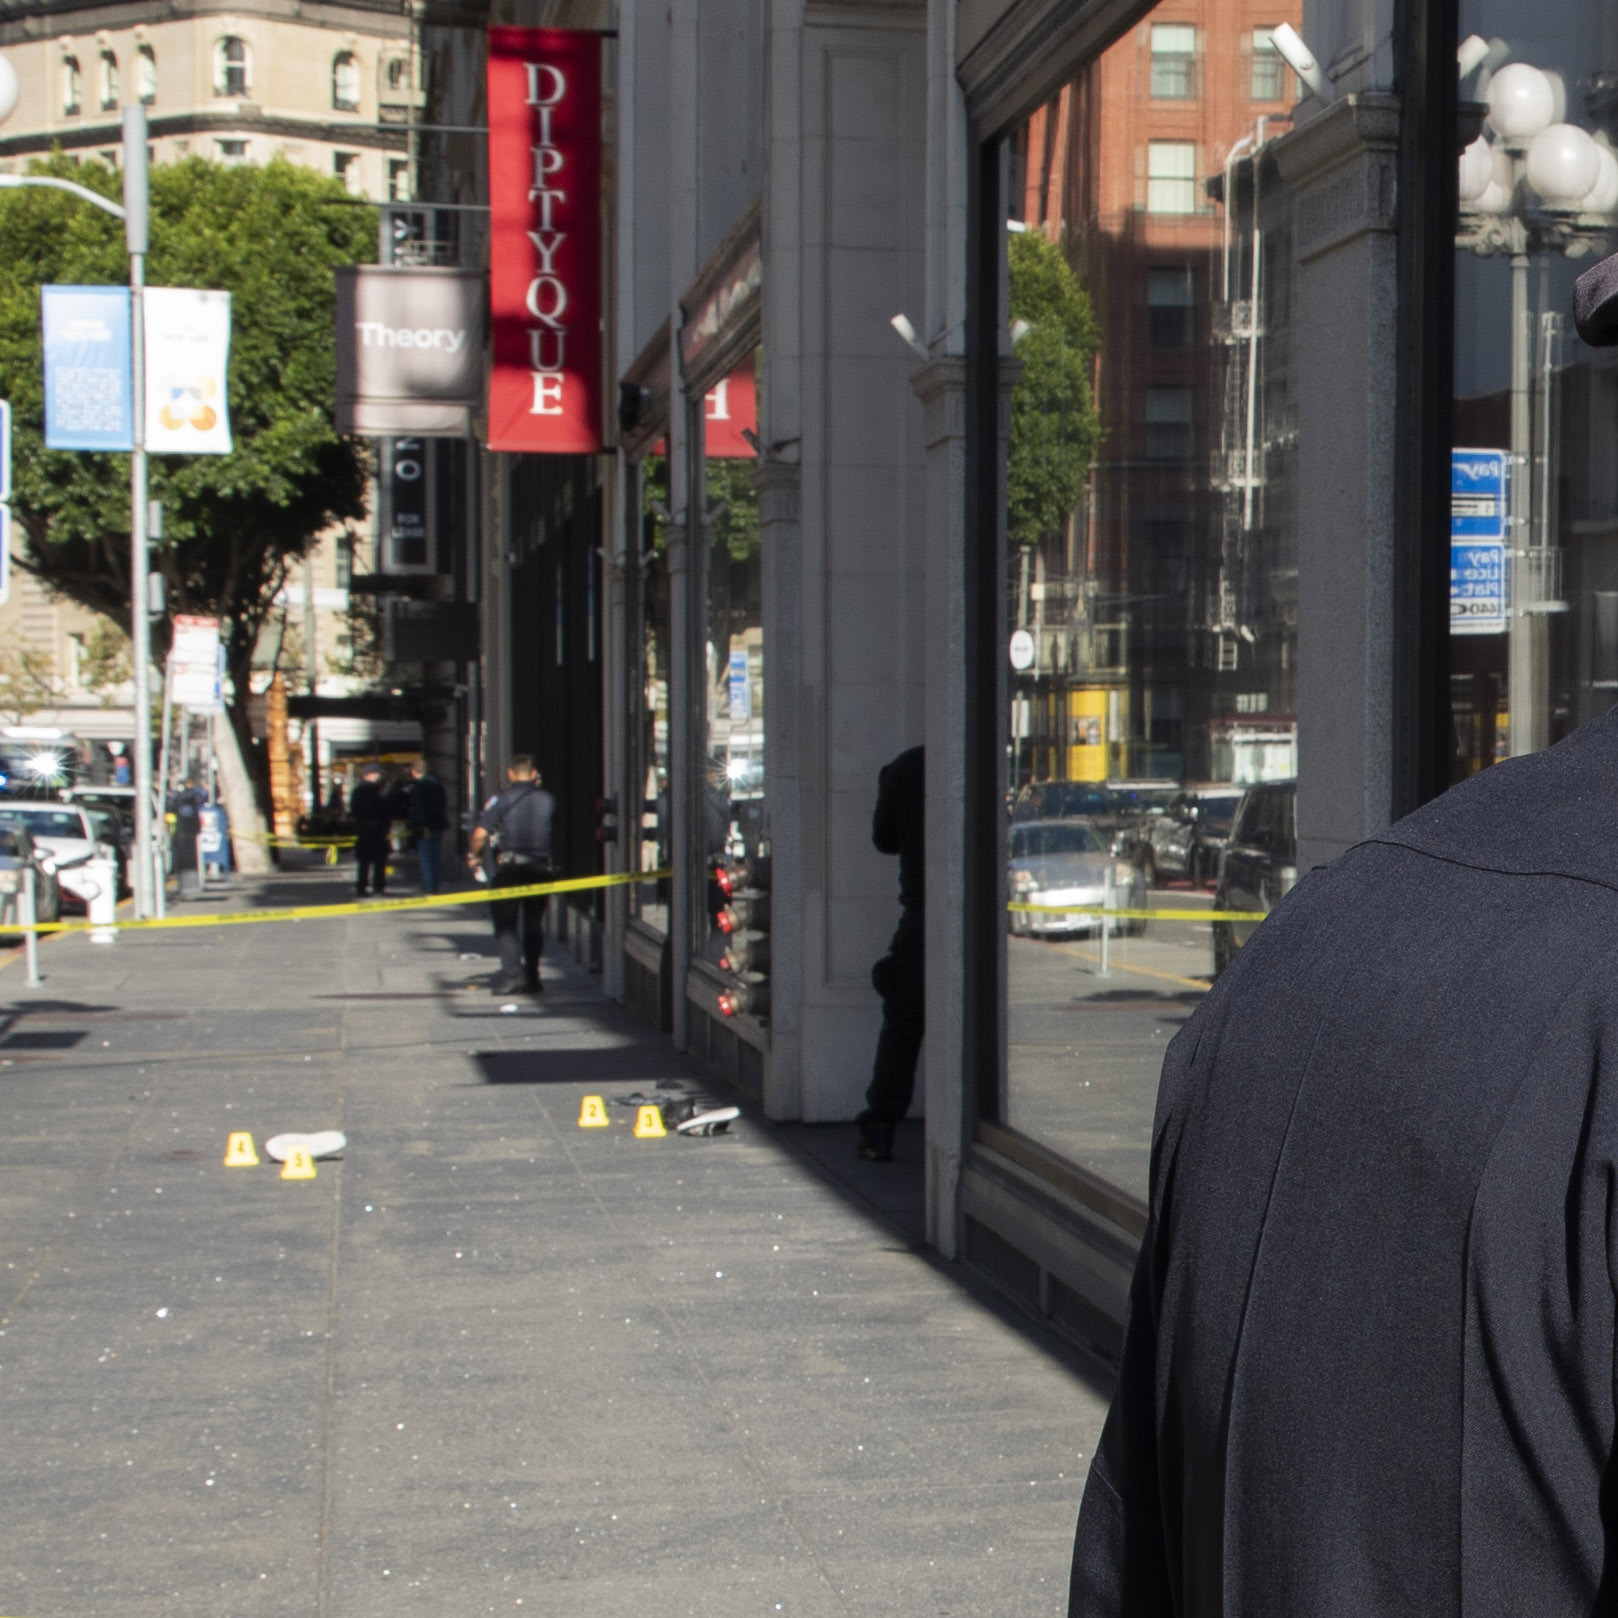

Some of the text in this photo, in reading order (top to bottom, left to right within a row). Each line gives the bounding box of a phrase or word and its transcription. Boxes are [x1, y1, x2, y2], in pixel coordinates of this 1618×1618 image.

[523, 62, 568, 415] DIPTYQUE
[356, 321, 466, 354] Theory
[588, 1103, 598, 1118] 2
[644, 1113, 653, 1128] 3
